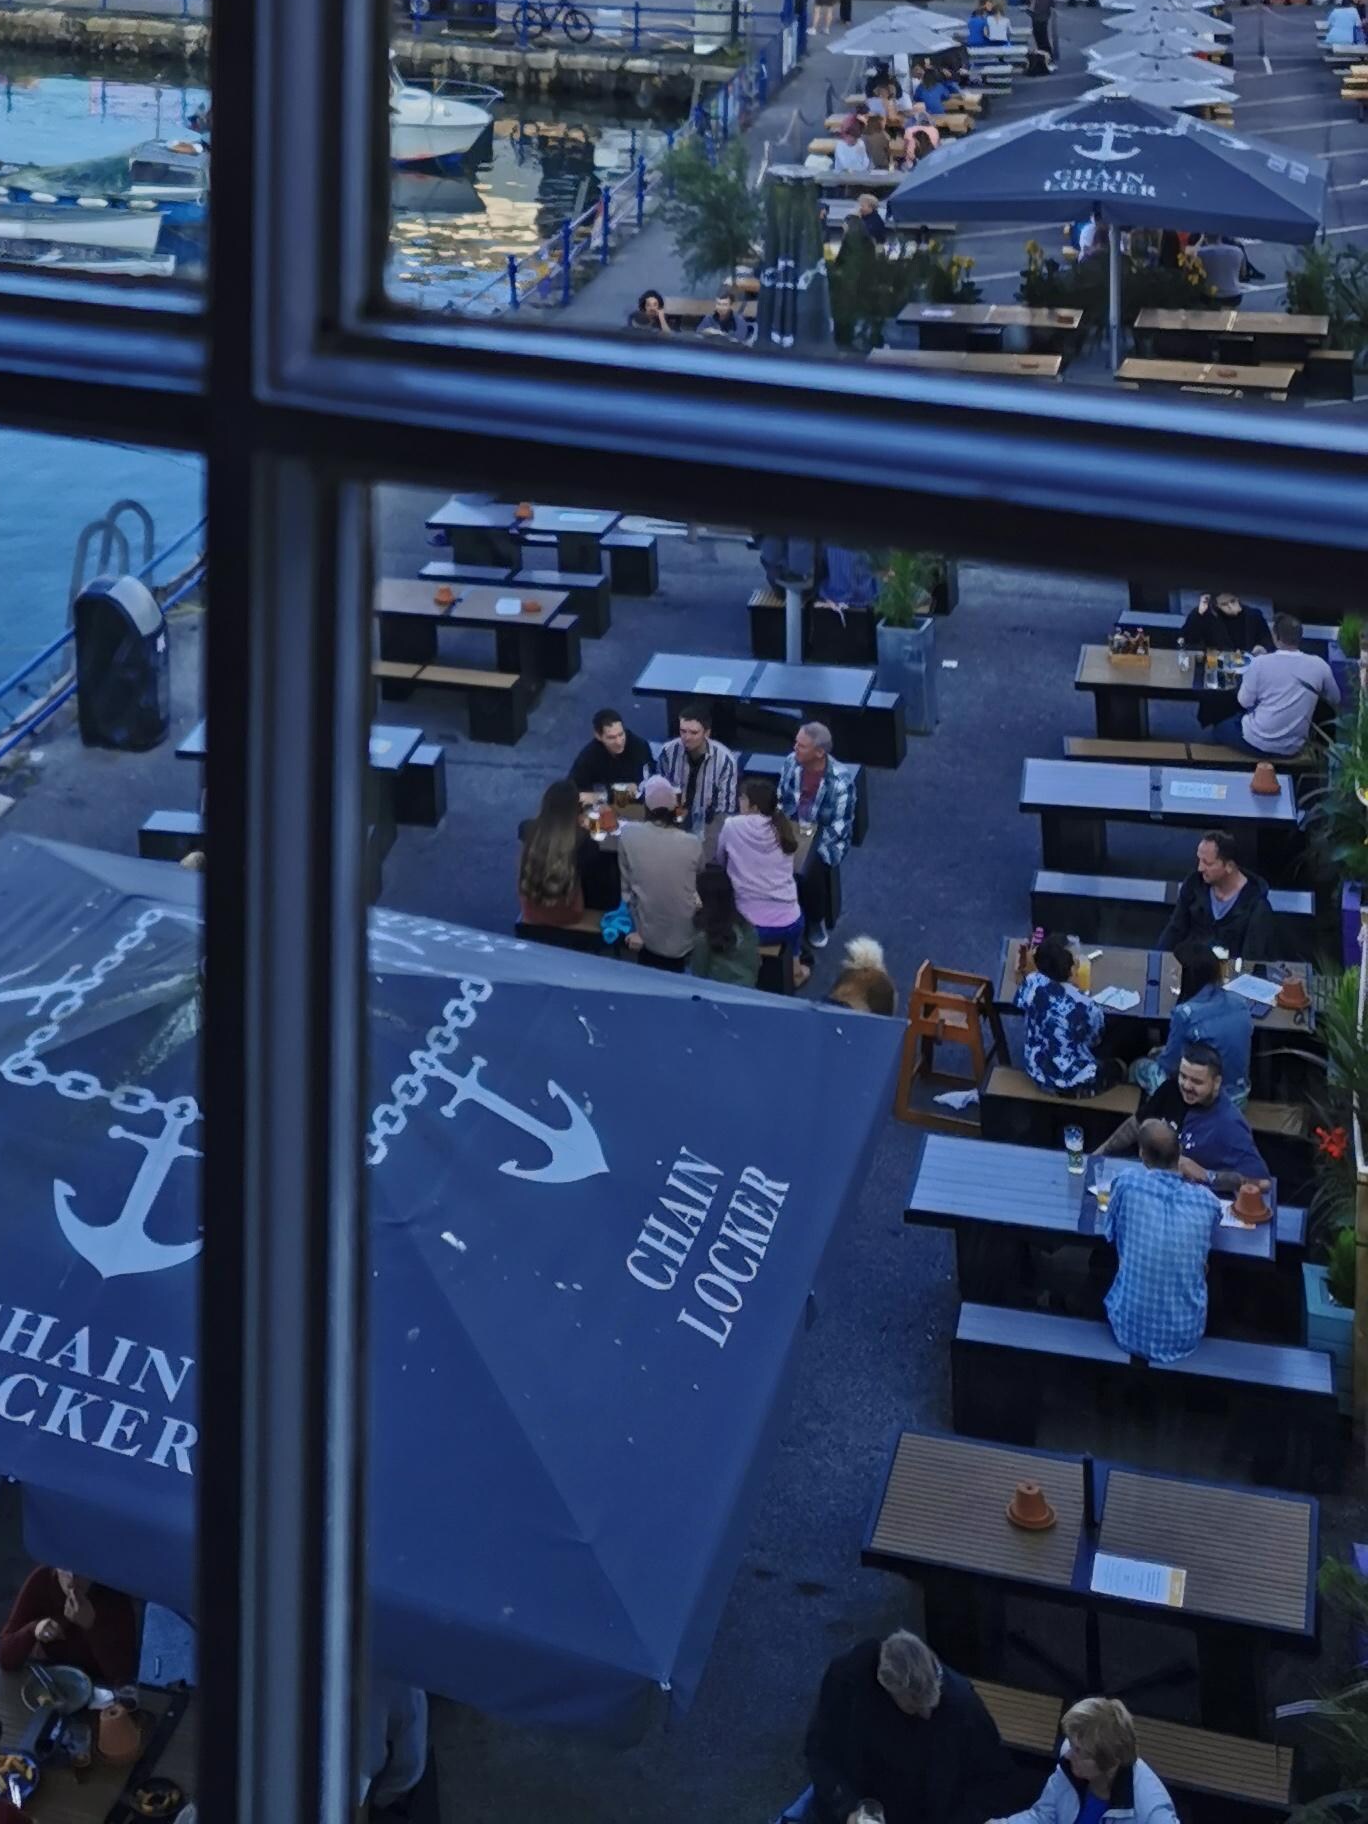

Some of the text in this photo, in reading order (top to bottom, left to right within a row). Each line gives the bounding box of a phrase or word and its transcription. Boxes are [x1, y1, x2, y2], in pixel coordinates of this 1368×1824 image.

[1043, 179, 1158, 198] LOCKER
[1053, 168, 1145, 185] CHAIN
[626, 1145, 725, 1291] CHAIN
[676, 1165, 791, 1349] LOCKER
